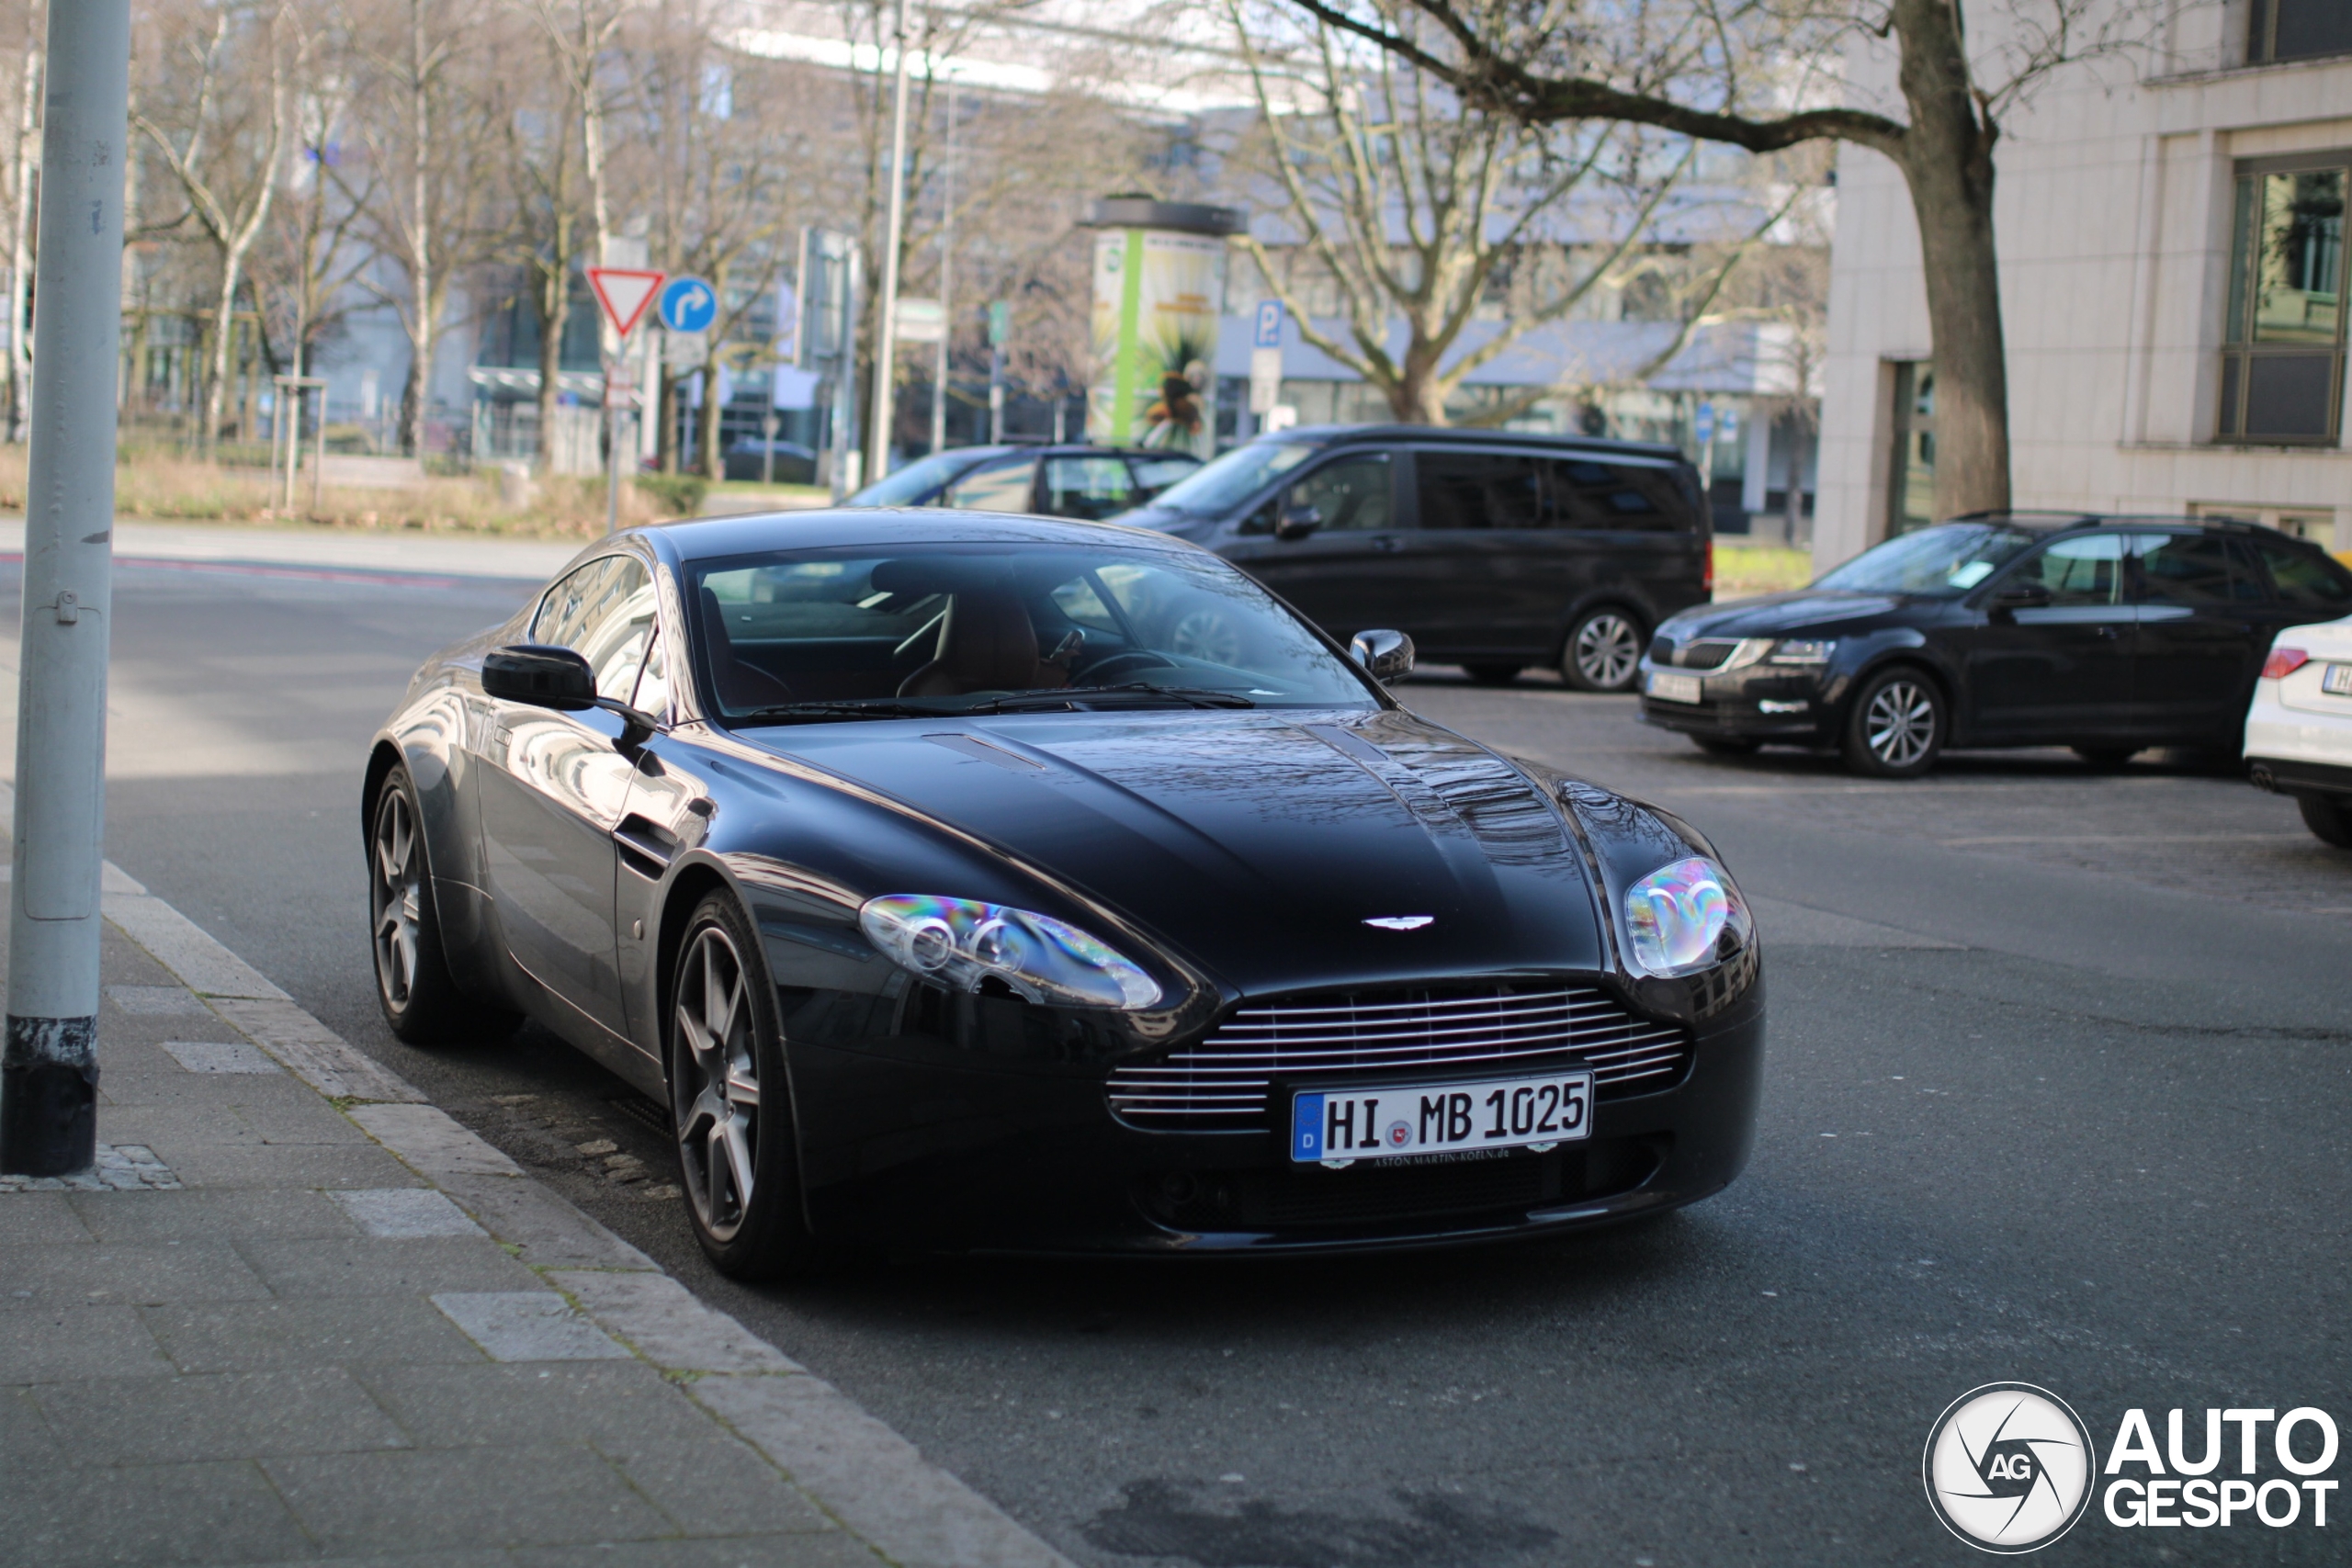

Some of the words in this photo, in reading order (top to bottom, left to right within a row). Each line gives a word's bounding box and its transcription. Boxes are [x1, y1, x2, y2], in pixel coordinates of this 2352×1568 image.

[1259, 305, 1279, 344] P
[1327, 1099, 1380, 1150] HI
[1419, 1093, 1472, 1145] MB
[1485, 1081, 1585, 1139] 1025
[1303, 1134, 1313, 1148] D
[1374, 1156, 1413, 1168] ASTON
